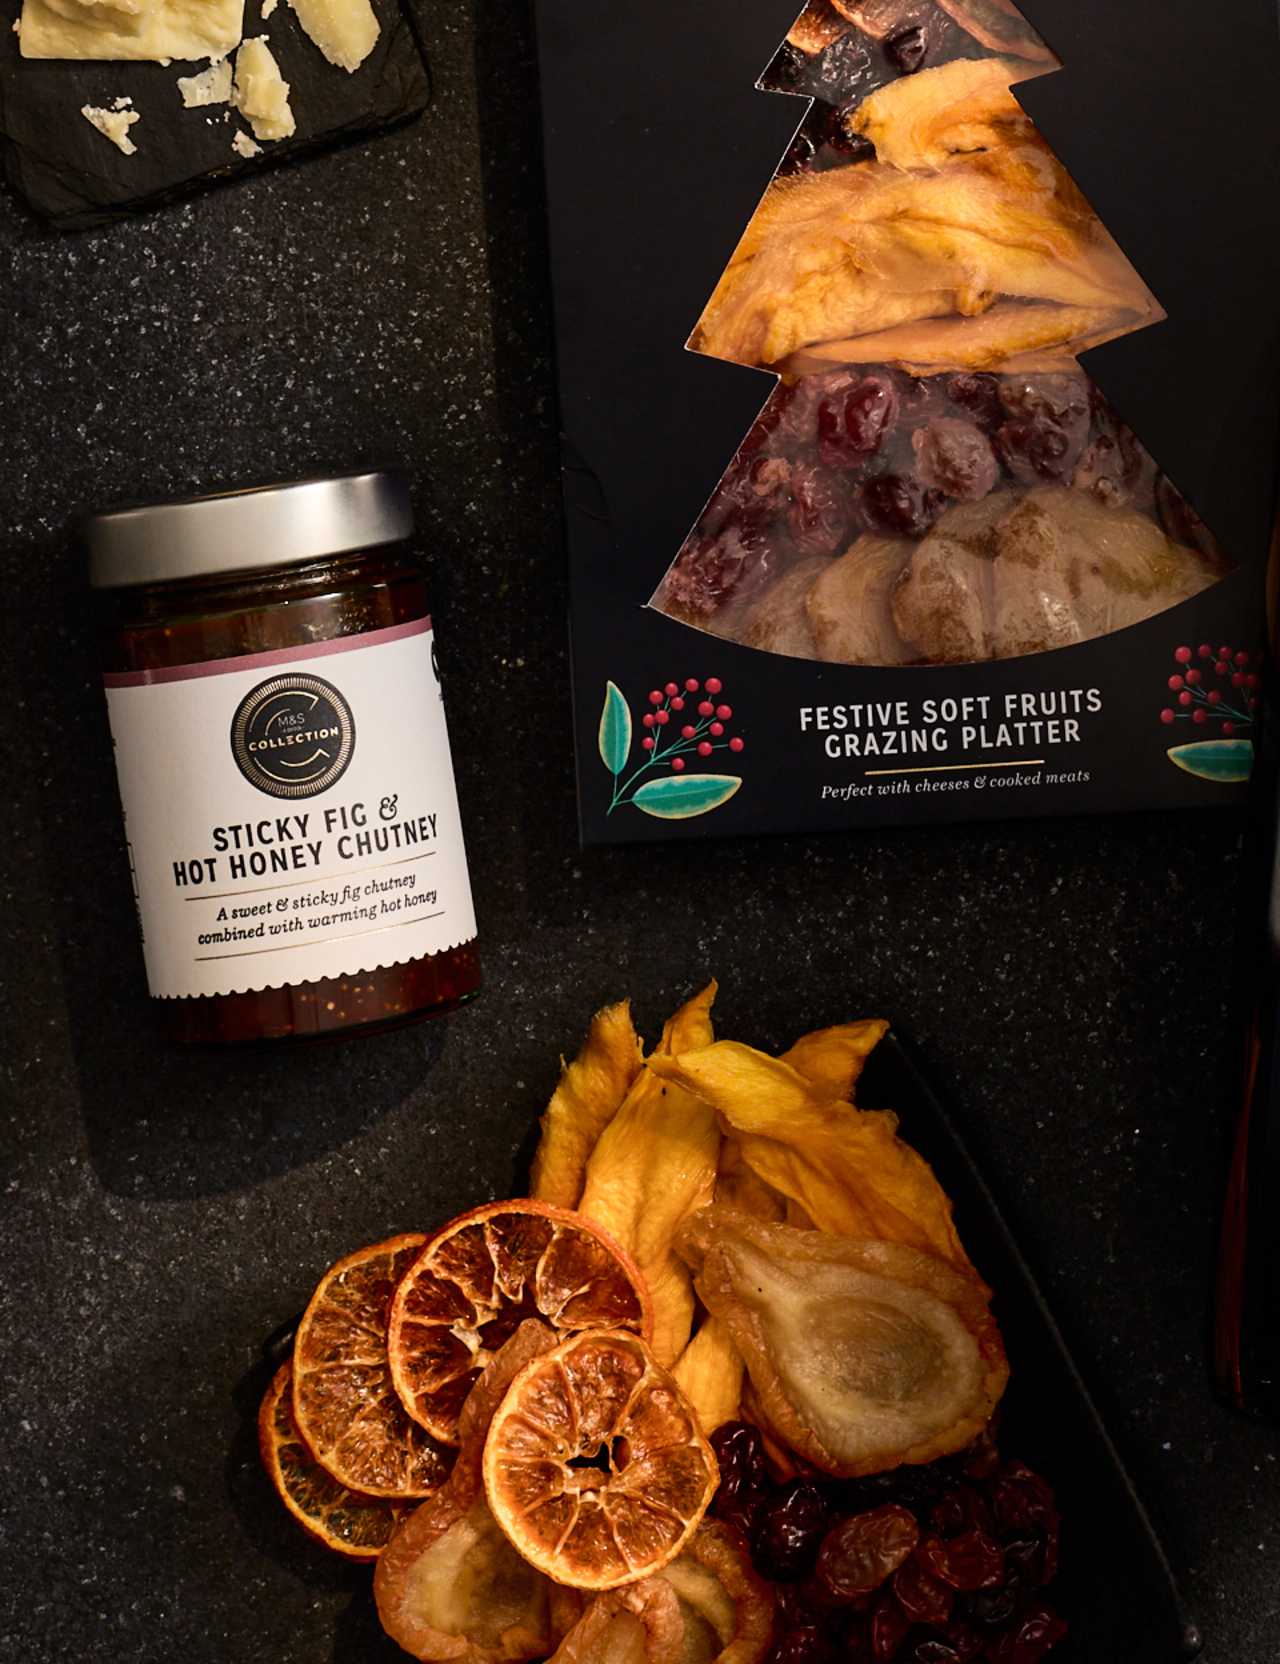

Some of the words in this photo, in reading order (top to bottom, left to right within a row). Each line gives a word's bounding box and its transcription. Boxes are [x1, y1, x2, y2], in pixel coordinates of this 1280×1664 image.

[278, 713, 305, 727] M&S
[800, 702, 910, 731] FESTIVE
[923, 696, 991, 723] SOFT
[1005, 688, 1102, 718] FRUITS
[249, 727, 339, 752] COLLECTION
[825, 727, 948, 758] GRAZING
[962, 719, 1081, 749] PLATTER
[822, 784, 873, 800] Perfect
[878, 780, 911, 795] with
[915, 779, 970, 792] cheeses
[974, 776, 987, 788] &
[990, 772, 1041, 787] cooked
[1046, 770, 1090, 784] meats
[213, 814, 309, 852] STICKY
[324, 803, 367, 833] FIG
[379, 794, 398, 820] &
[172, 858, 217, 886] HOT
[230, 841, 322, 880] HONEY
[337, 814, 438, 859] CHUTNEY
[198, 924, 265, 944] combined
[269, 917, 303, 936] with
[306, 904, 377, 928] warming
[380, 899, 401, 913] hot
[404, 889, 438, 909] honey
[216, 908, 228, 921] A
[231, 902, 272, 920] sweet
[276, 898, 290, 911] &
[292, 890, 339, 908] sticky
[339, 885, 361, 905] fig
[364, 874, 416, 898] chutney
